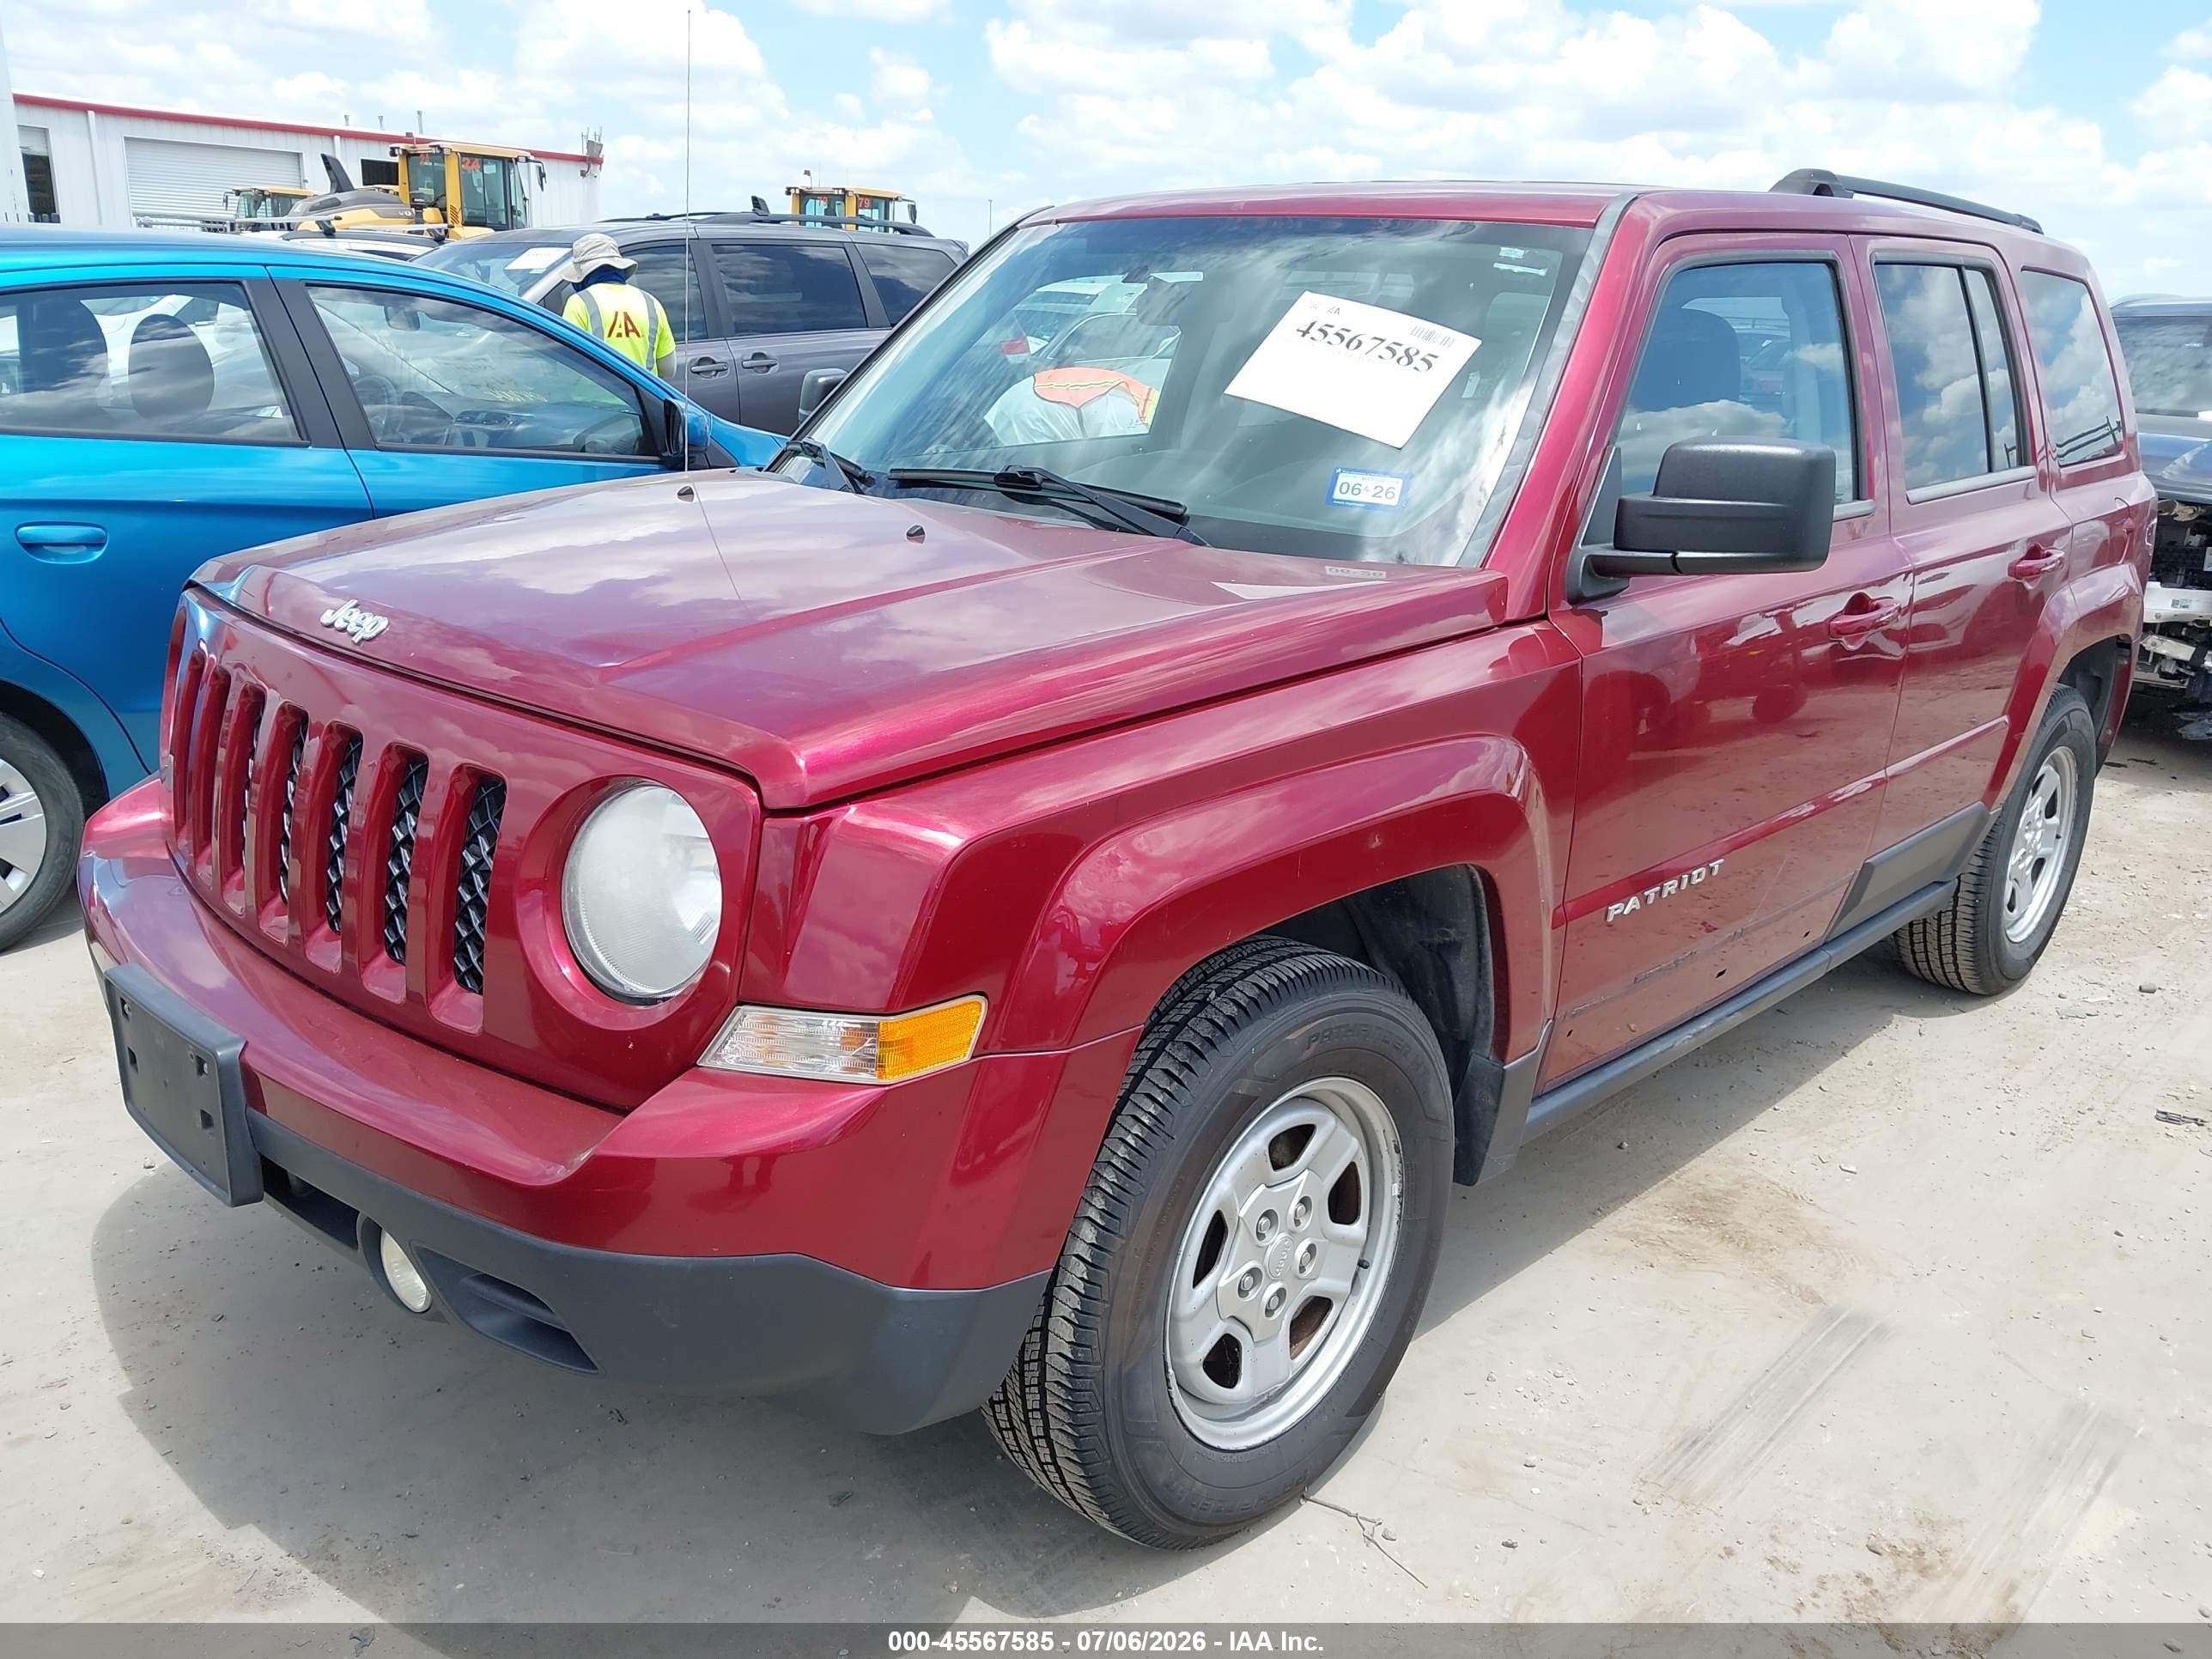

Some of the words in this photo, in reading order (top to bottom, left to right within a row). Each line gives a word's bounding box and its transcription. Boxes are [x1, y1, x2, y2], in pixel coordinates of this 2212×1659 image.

[859, 198, 871, 208] 79
[1296, 320, 1440, 372] 45567585
[1340, 482, 1362, 495] 06
[1372, 485, 1395, 500] 26
[319, 599, 389, 644] Jeep
[1606, 858, 1725, 922] PATRIOT
